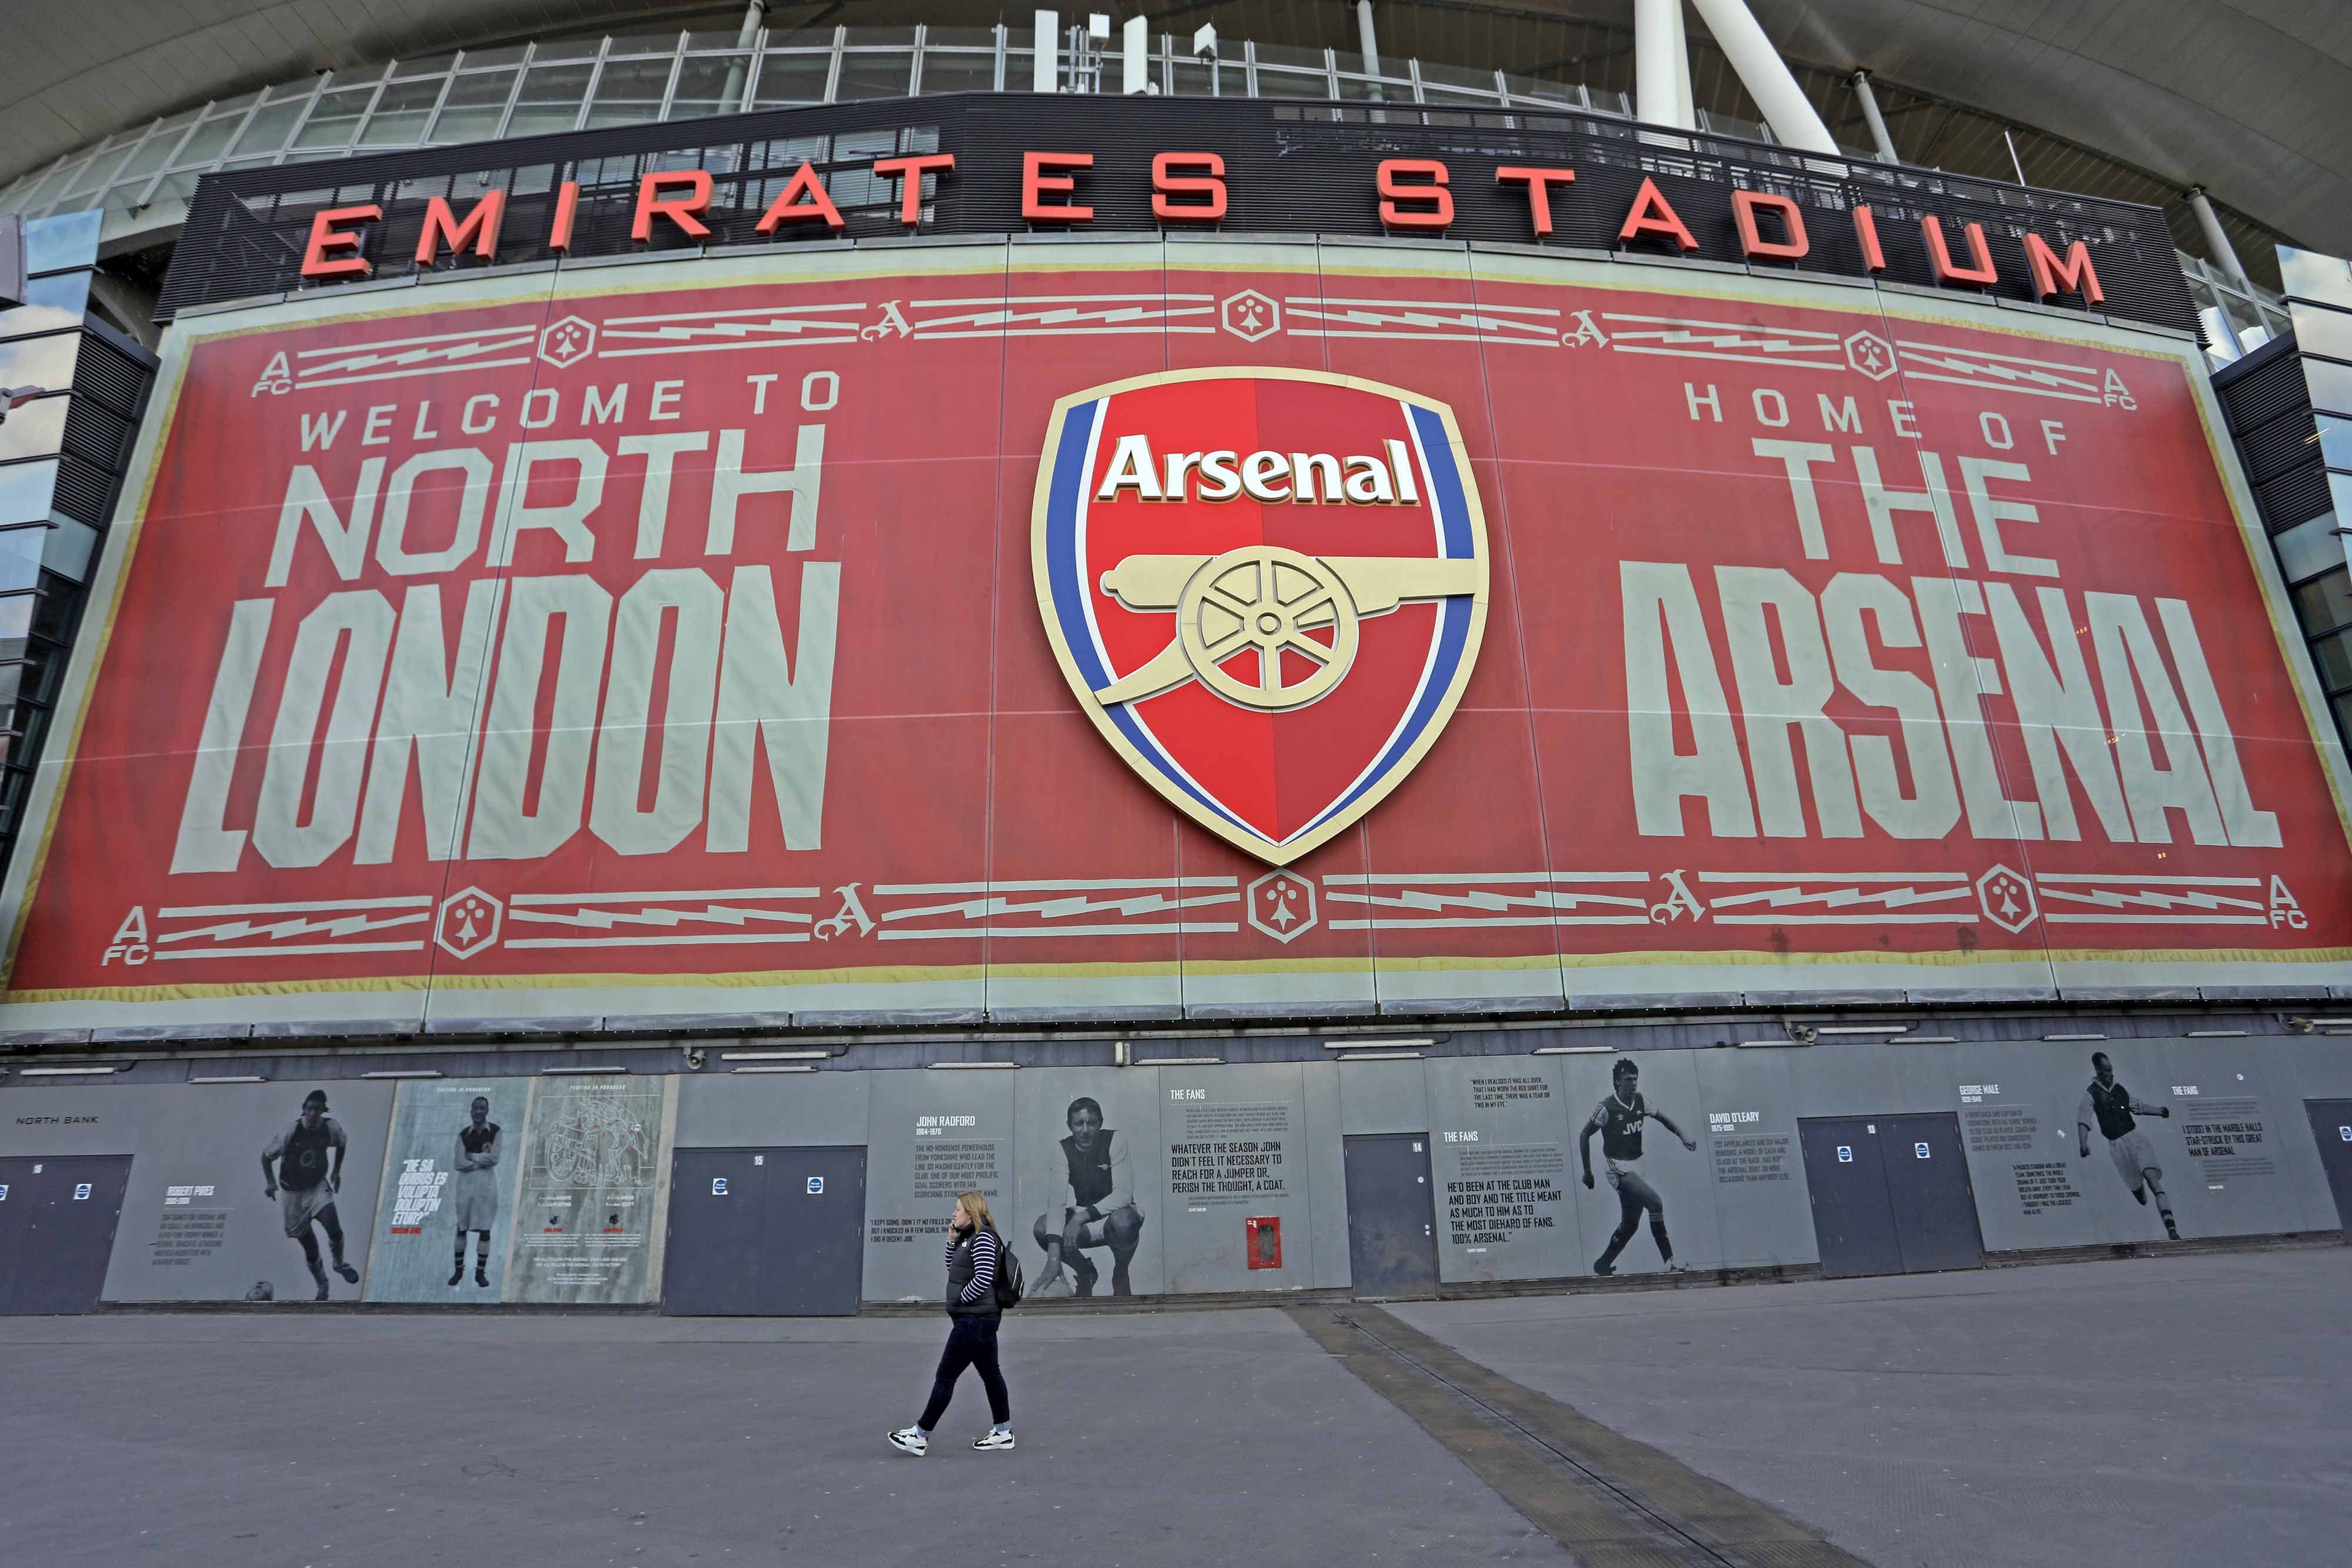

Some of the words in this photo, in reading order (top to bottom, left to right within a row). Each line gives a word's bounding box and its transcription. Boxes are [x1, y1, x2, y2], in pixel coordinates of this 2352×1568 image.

[301, 152, 1227, 279] EMIRATES
[1377, 159, 2104, 305] STADIUM
[300, 380, 685, 451] WELCOME
[747, 371, 840, 414] TO
[1683, 383, 1923, 439] HOME
[1979, 412, 2066, 455] OF
[1093, 434, 1420, 506] Arsenal
[263, 424, 826, 588] NORTH
[1751, 437, 2060, 578] THE
[1619, 560, 2283, 848] ARSENAL
[169, 561, 841, 875] LONDON
[1170, 1090, 1184, 1099] THE
[1186, 1089, 1205, 1099] FANS
[1983, 1085, 1999, 1094] MALE
[2172, 1087, 2184, 1095] THE
[2183, 1086, 2199, 1095] FANS
[917, 1117, 937, 1126] JOHN
[940, 1116, 975, 1126] RADFORD
[1709, 1113, 1730, 1123] DAVID
[1732, 1112, 1759, 1122] O'LEARY
[1623, 1120, 1642, 1134] JVC
[2187, 1125, 2204, 1133] STOOD
[2211, 1124, 2222, 1133] THE
[2223, 1123, 2244, 1132] MARBLE
[2245, 1122, 2263, 1131] HALLS
[1444, 1132, 1458, 1142] THE
[1460, 1131, 1478, 1141] FANS
[2185, 1136, 2223, 1145] STAR-STRUCK
[2223, 1136, 2231, 1144] BY
[2233, 1134, 2245, 1143] THIS
[2245, 1134, 2263, 1143] GREAT
[1171, 1143, 1210, 1154] WHATEVER
[1214, 1143, 1227, 1153] THE
[1229, 1142, 1258, 1153] SEASON
[1261, 1142, 1281, 1152] JOHN
[1414, 1143, 1422, 1152] 14
[2189, 1148, 2202, 1156] MAN
[755, 1156, 763, 1165] 15
[1172, 1156, 1196, 1167] DIDN'T
[1199, 1156, 1215, 1167] FEEL
[1218, 1156, 1224, 1166] IT
[1227, 1155, 1270, 1166] NECESSARY
[1272, 1155, 1281, 1164] TO
[1172, 1169, 1197, 1180] REACH
[1200, 1169, 1214, 1179] FOR
[1216, 1169, 1221, 1178] A
[1224, 1168, 1254, 1178] JUMPER
[1257, 1167, 1270, 1178] OR,
[1173, 1182, 1199, 1193] PERISH
[1202, 1182, 1215, 1192] THE
[1218, 1181, 1254, 1192] THOUGHT,
[1256, 1180, 1262, 1190] A
[1264, 1180, 1284, 1190] COAT.
[1448, 1182, 1463, 1193] HE'D
[1466, 1182, 1484, 1191] BEEN
[1487, 1181, 1495, 1191] AT
[1497, 1180, 1510, 1190] THE
[1513, 1180, 1532, 1189] CLUB
[1534, 1178, 1550, 1189] MAN
[1449, 1195, 1463, 1205] AND
[1466, 1194, 1481, 1204] BOY
[1483, 1194, 1498, 1204] AND
[1501, 1193, 1513, 1203] THE
[1516, 1192, 1535, 1202] TITLE
[1537, 1191, 1562, 1202] MEANT
[1450, 1208, 1460, 1218] AS
[1462, 1207, 1483, 1218] MUCH
[1485, 1207, 1494, 1216] TO
[1497, 1206, 1510, 1216] HIM
[1513, 1205, 1522, 1215] AS
[1524, 1205, 1534, 1215] TO
[1451, 1221, 1464, 1231] THE
[1467, 1219, 1486, 1231] MOST
[1489, 1218, 1520, 1229] DIEHARD
[1523, 1218, 1532, 1228] OF
[1534, 1217, 1555, 1227] FANS.
[1452, 1234, 1472, 1245] 100%
